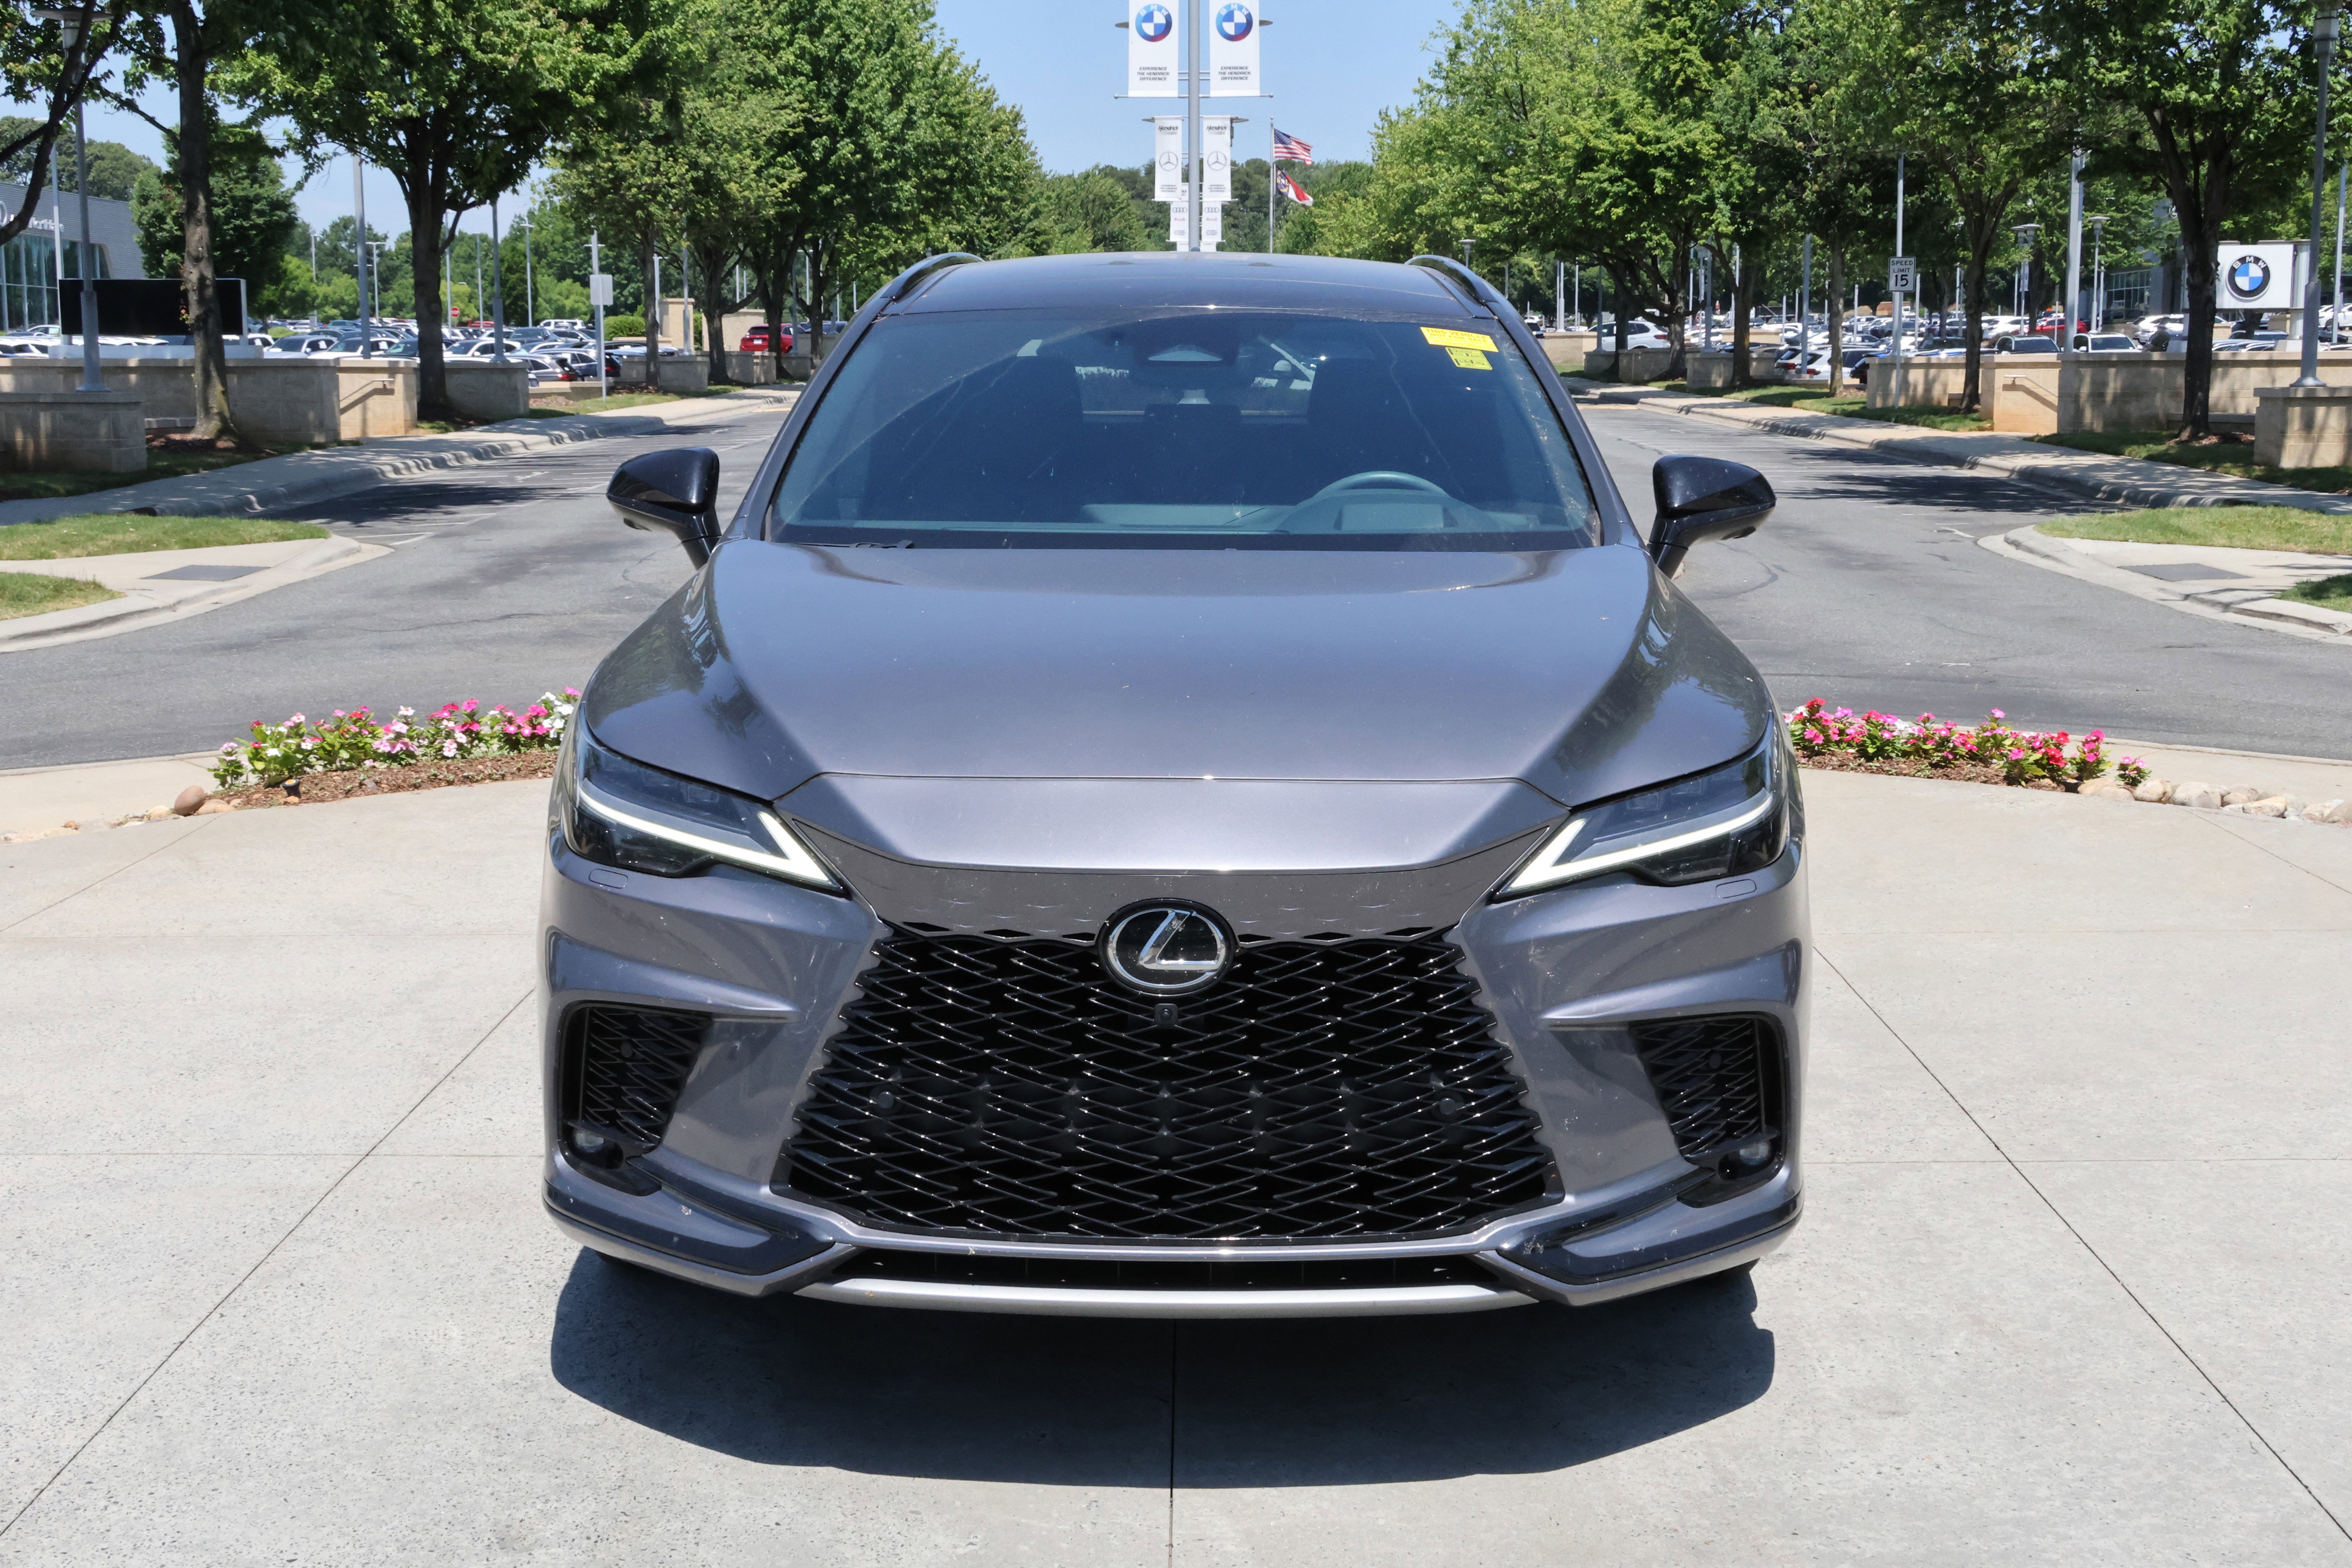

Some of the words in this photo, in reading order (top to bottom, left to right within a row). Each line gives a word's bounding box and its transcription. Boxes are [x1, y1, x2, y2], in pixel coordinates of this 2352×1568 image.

[1139, 4, 1169, 16] BMW
[1219, 4, 1249, 16] BMW
[2232, 256, 2267, 270] BMW
[1895, 274, 1909, 287] 15
[1448, 331, 1486, 339] VEHICLE
